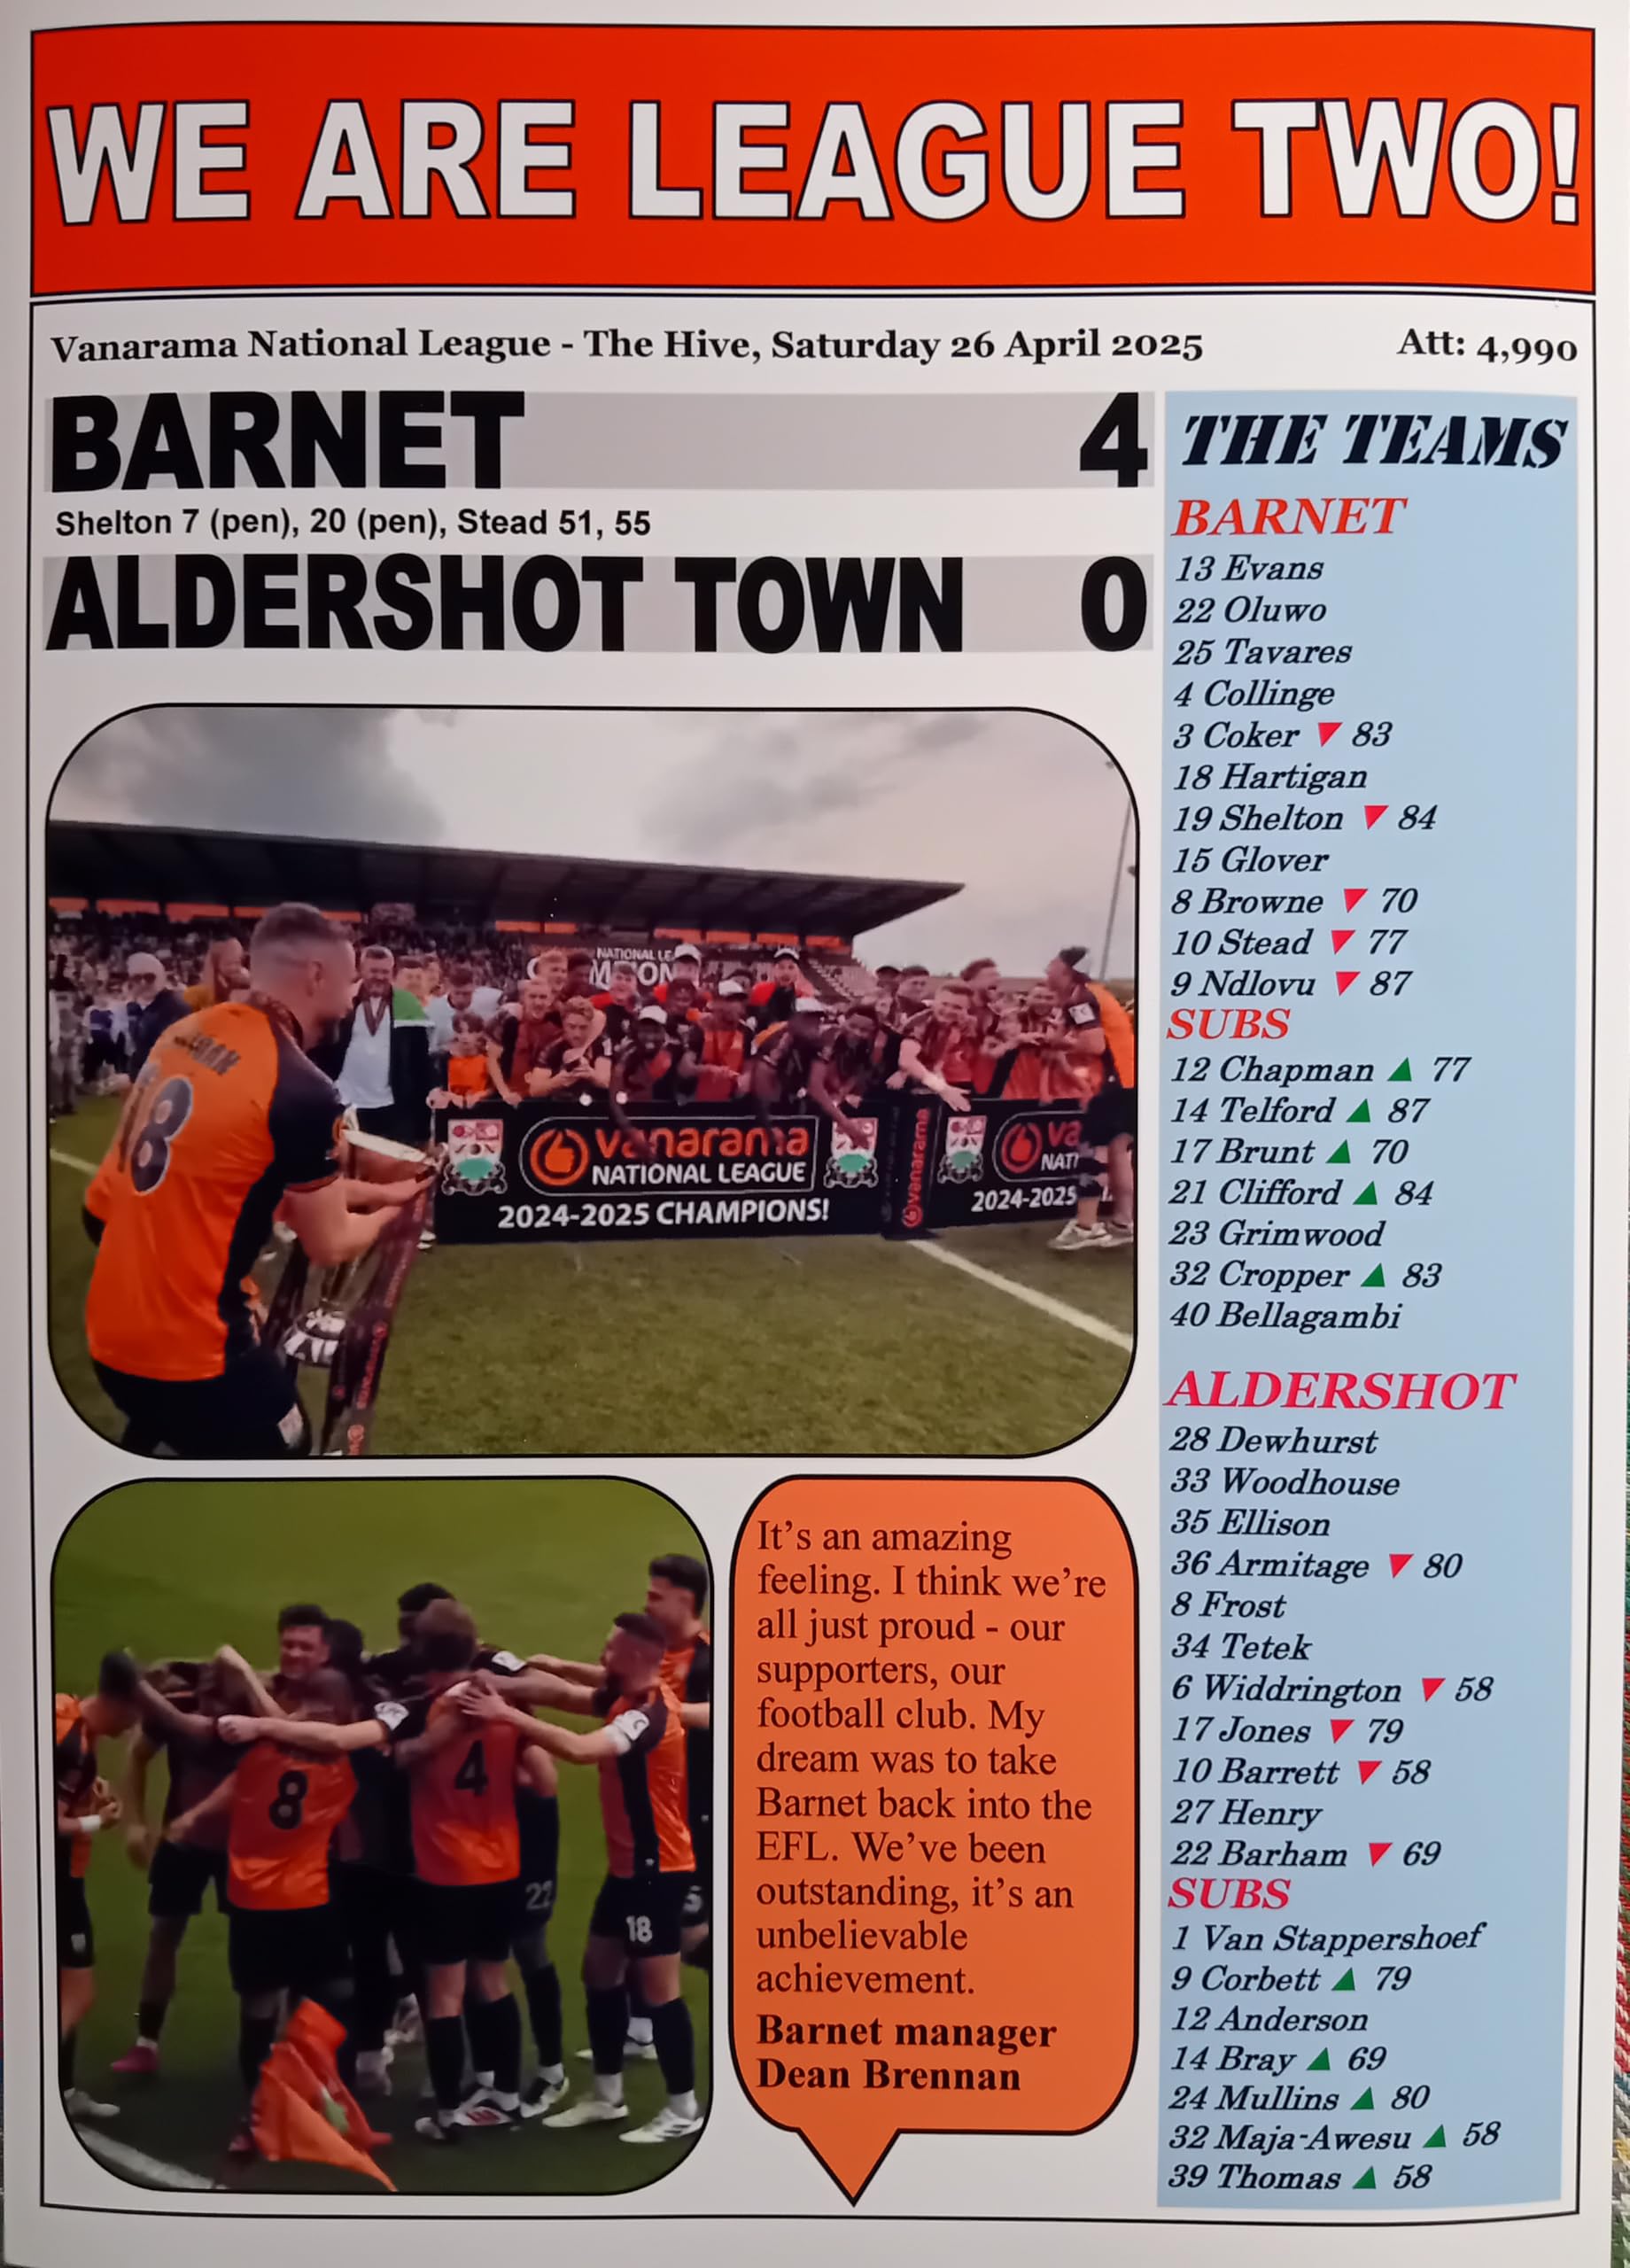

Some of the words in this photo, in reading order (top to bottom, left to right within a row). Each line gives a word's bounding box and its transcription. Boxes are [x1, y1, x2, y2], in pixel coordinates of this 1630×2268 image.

[46, 100, 250, 226] WE
[295, 99, 575, 219] ARE
[629, 100, 1185, 222] LEAGUE
[1231, 98, 1579, 225] TWO!
[50, 336, 238, 363] Vanarama
[247, 327, 408, 357] National
[418, 329, 551, 364] League
[583, 328, 653, 358] The
[664, 329, 761, 364] Hive,
[772, 330, 941, 366] Saturday
[951, 330, 995, 358] 26
[1004, 328, 1100, 365] April
[1112, 334, 1203, 361] 2025
[1397, 328, 1464, 356] Att:
[1477, 336, 1578, 365] 4,990
[51, 390, 525, 493] BARNET
[1080, 392, 1148, 488] 4
[1182, 414, 1329, 466] THE
[1342, 414, 1569, 469] TEAMS
[56, 509, 172, 537] Shelton
[182, 508, 199, 533] 7
[210, 507, 299, 540] (pen),
[310, 507, 346, 533] 20
[357, 507, 446, 540] (pen),
[457, 508, 547, 535] Stead
[559, 509, 603, 540] 51,
[615, 509, 651, 536] 55
[1171, 497, 1409, 537] BARNET
[1176, 555, 1215, 582] 13
[1221, 554, 1324, 581] Evans
[45, 553, 644, 653] ALDERSHOT
[674, 555, 963, 654] TOWN
[1081, 555, 1147, 652] 0
[1172, 639, 1216, 665] 25
[1224, 637, 1353, 665] Tavares
[1173, 723, 1195, 750] 3
[1204, 720, 1301, 749] Coker
[1352, 721, 1393, 747] 83
[1173, 765, 1214, 790] 18
[1219, 762, 1368, 796] Hartigan
[1173, 805, 1213, 832] 19
[1218, 804, 1344, 831] Shelton
[1398, 804, 1438, 830] 84
[596, 947, 656, 961] NATIONAL
[1171, 929, 1212, 956] 10
[1217, 928, 1315, 955] Stead
[1370, 928, 1409, 955] 77
[1170, 971, 1192, 997] 9
[1197, 969, 1316, 997] Ndlovu
[1370, 970, 1414, 997] 87
[1166, 1008, 1291, 1040] SUBS
[1170, 1056, 1211, 1082] 12
[1220, 1054, 1374, 1088] Chapman
[1433, 1056, 1472, 1083] 77
[1170, 1138, 1213, 1164] 17
[1215, 1137, 1316, 1164] Brunt
[1372, 1138, 1409, 1165] 70
[592, 1163, 711, 1185] NATIONAL
[718, 1161, 806, 1184] LEAGUE
[971, 1185, 1077, 1213] 2024-2025
[1168, 1179, 1207, 1205] 21
[1219, 1177, 1344, 1206] Clifford
[1394, 1180, 1434, 1206] 84
[498, 1202, 649, 1228] 2024-2025
[656, 1198, 829, 1224] CHAMPIONS!
[1169, 1261, 1211, 1286] 32
[1219, 1259, 1351, 1293] Cropper
[1401, 1262, 1443, 1288] 83
[1169, 1301, 1211, 1327] 40
[1215, 1301, 1403, 1335] Bellagambi
[1162, 1370, 1519, 1410] ALDERSHOT
[1168, 1425, 1211, 1452] 28
[1215, 1425, 1379, 1455] Dewhurst
[1170, 1508, 1213, 1534] 35
[1216, 1508, 1331, 1536] Ellison
[822, 1529, 861, 1550] an
[872, 1520, 1013, 1560] amazing
[757, 1563, 880, 1604] feeling.
[893, 1565, 904, 1595] I
[916, 1564, 1002, 1596] think
[1170, 1550, 1212, 1576] 36
[1215, 1549, 1370, 1585] Armitage
[1423, 1553, 1463, 1579] 80
[757, 1607, 797, 1639] all
[804, 1607, 869, 1648] just
[878, 1609, 975, 1649] proud
[1010, 1619, 1066, 1642] our
[1171, 1632, 1211, 1658] 34
[1221, 1632, 1314, 1660] Tetek
[757, 1657, 938, 1692] supporters,
[951, 1663, 1006, 1685] our
[1172, 1674, 1193, 1700] 6
[1205, 1674, 1401, 1709] Widdrington
[1455, 1676, 1494, 1702] 58
[757, 1697, 884, 1728] football
[896, 1697, 975, 1730] club.
[989, 1699, 1045, 1739] My
[1172, 1715, 1215, 1743] 17
[1218, 1715, 1312, 1744] Jones
[1369, 1718, 1404, 1744] 79
[454, 1740, 488, 1797] 4
[757, 1741, 859, 1773] dream
[870, 1751, 935, 1774] was
[944, 1747, 977, 1775] to
[988, 1744, 1057, 1775] take
[1172, 1757, 1213, 1783] 10
[1217, 1757, 1341, 1785] Barrett
[1392, 1759, 1432, 1785] 58
[269, 1770, 307, 1829] 8
[757, 1786, 867, 1818] Barnet
[877, 1786, 956, 1819] back
[967, 1787, 1030, 1820] into
[1041, 1789, 1092, 1821] the
[757, 1830, 838, 1861] EFL.
[968, 1831, 1046, 1864] been
[1169, 1839, 1213, 1866] 22
[1216, 1839, 1347, 1868] Barham
[1402, 1840, 1442, 1867] 69
[756, 1875, 959, 1915] outstanding,
[1035, 1886, 1074, 1908] an
[1168, 1878, 1291, 1909] SUBS
[625, 1915, 653, 1943] 18
[757, 1918, 968, 1951] unbelievable
[1172, 1925, 1190, 1950] 1
[1204, 1924, 1264, 1952] Van
[1272, 1921, 1488, 1958] Stappershoef
[756, 1961, 974, 1995] achievement.
[757, 2014, 883, 2046] Barnet
[895, 2023, 1058, 2054] manager
[757, 2057, 850, 2089] Dean
[863, 2059, 1021, 2091] Brennan
[1170, 2046, 1210, 2070] 14
[1215, 2045, 1298, 2078] Bray
[1347, 2046, 1387, 2071] 69
[1168, 2124, 1210, 2150] 32
[1214, 2124, 1411, 2152] Maja-Awesu
[1463, 2121, 1502, 2148] 58
[1168, 2163, 1209, 2188] 39
[1217, 2163, 1342, 2190] Thomas
[1393, 2163, 1433, 2190] 58
